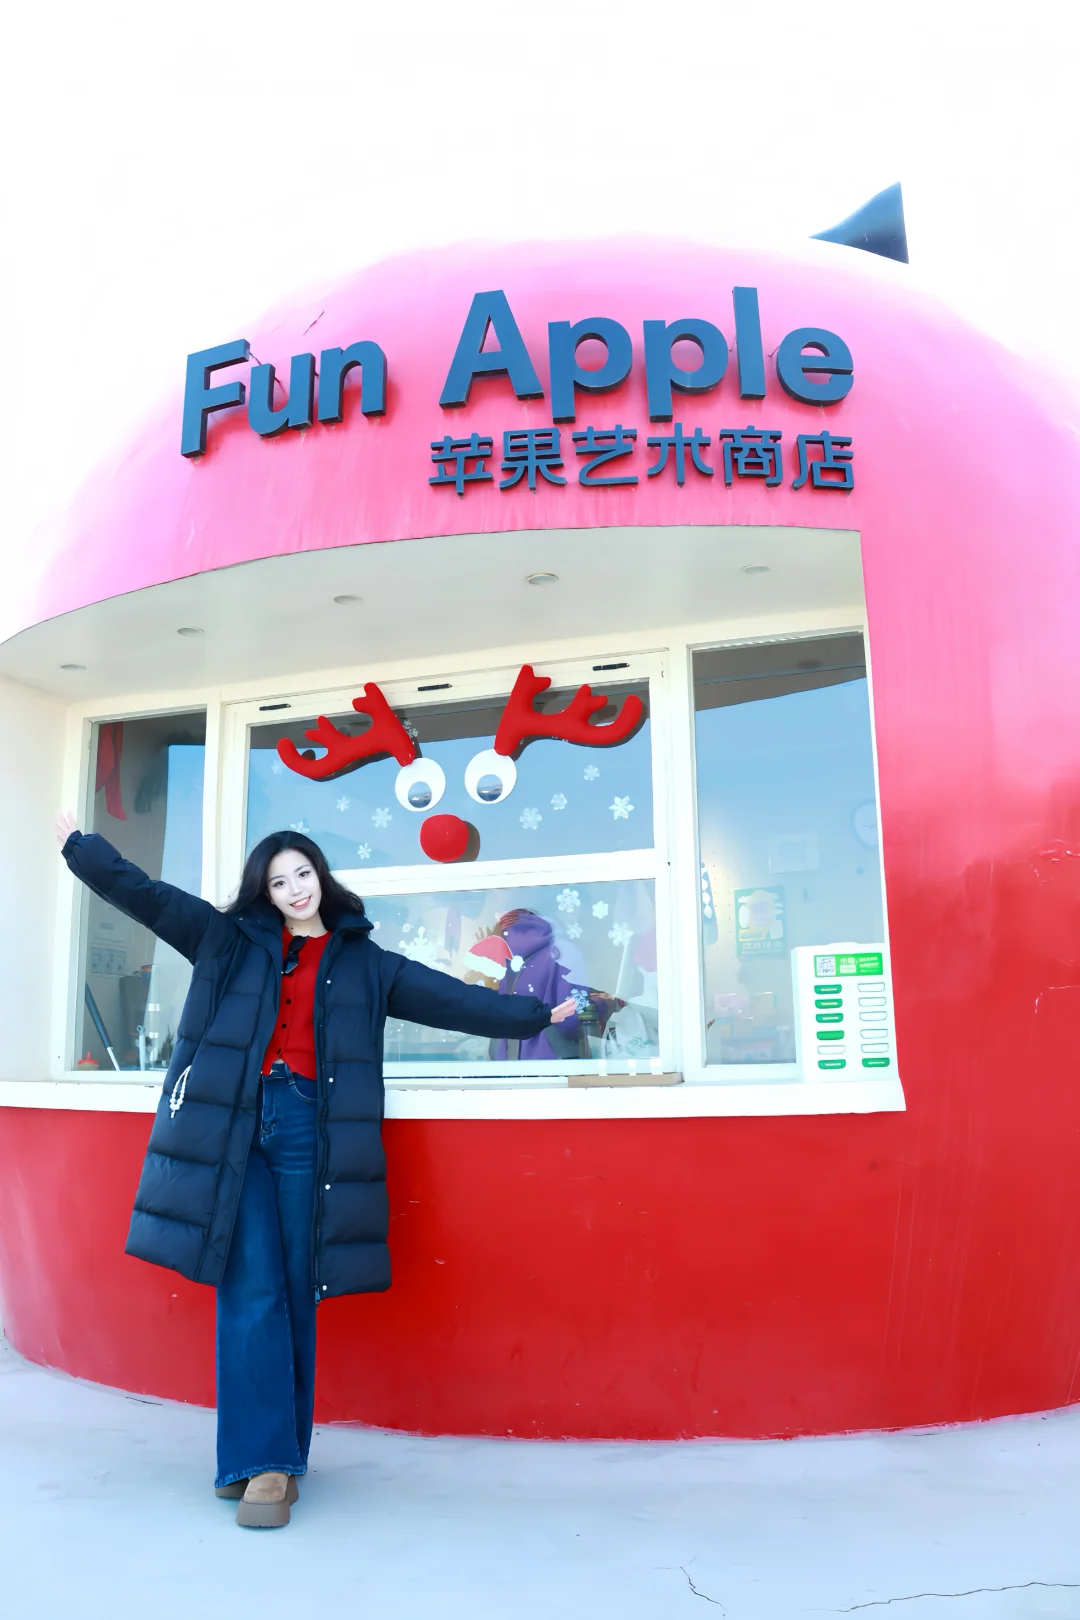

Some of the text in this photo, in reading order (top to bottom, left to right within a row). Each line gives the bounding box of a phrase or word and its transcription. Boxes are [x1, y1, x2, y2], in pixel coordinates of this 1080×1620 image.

[181, 286, 855, 458] Fun Apple
[428, 423, 855, 496] 苹果艺术商店
